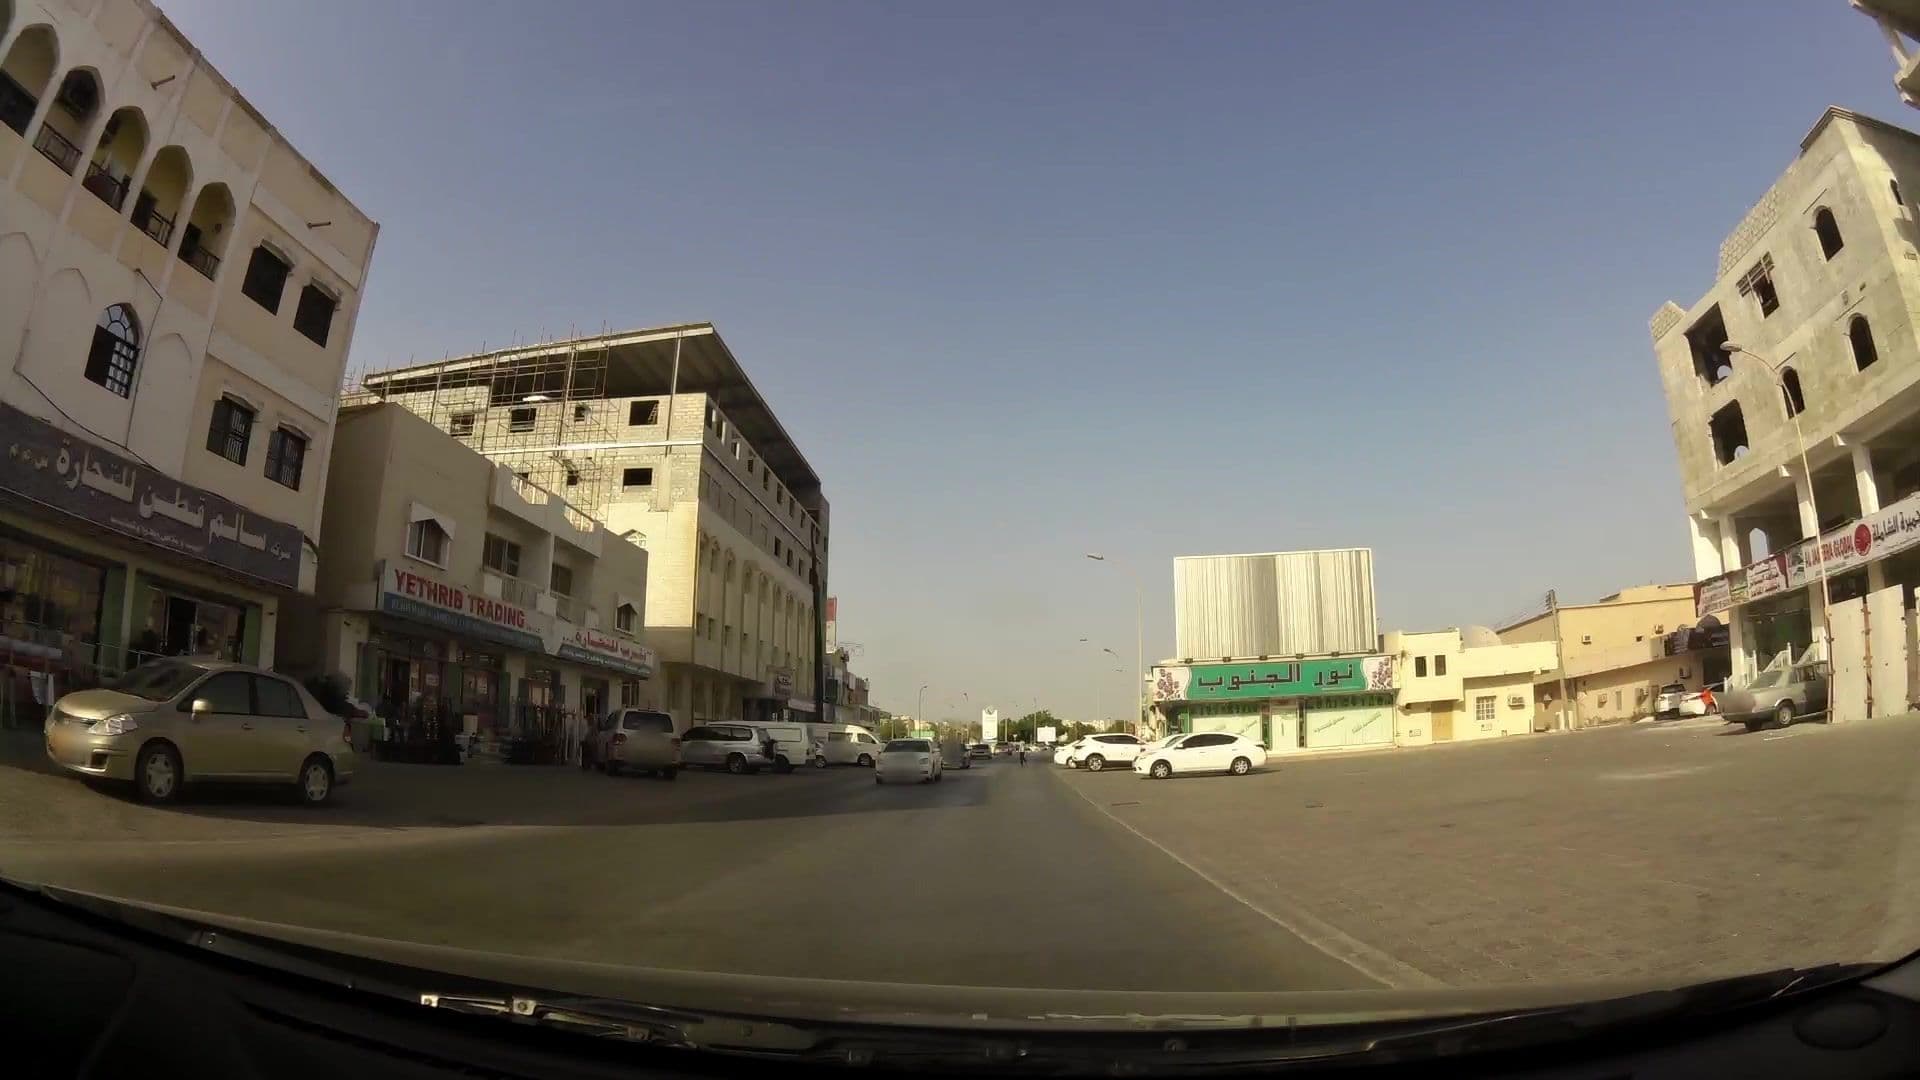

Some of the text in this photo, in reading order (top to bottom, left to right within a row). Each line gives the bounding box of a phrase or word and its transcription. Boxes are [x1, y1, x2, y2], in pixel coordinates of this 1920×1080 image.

[56, 437, 137, 504] للتجارة
[208, 512, 266, 551] سالم
[1832, 535, 1855, 558] GLOBAL
[394, 568, 464, 610] YETHRIB
[468, 594, 526, 629] TRADING
[1197, 663, 1353, 691] نور الجنوب
